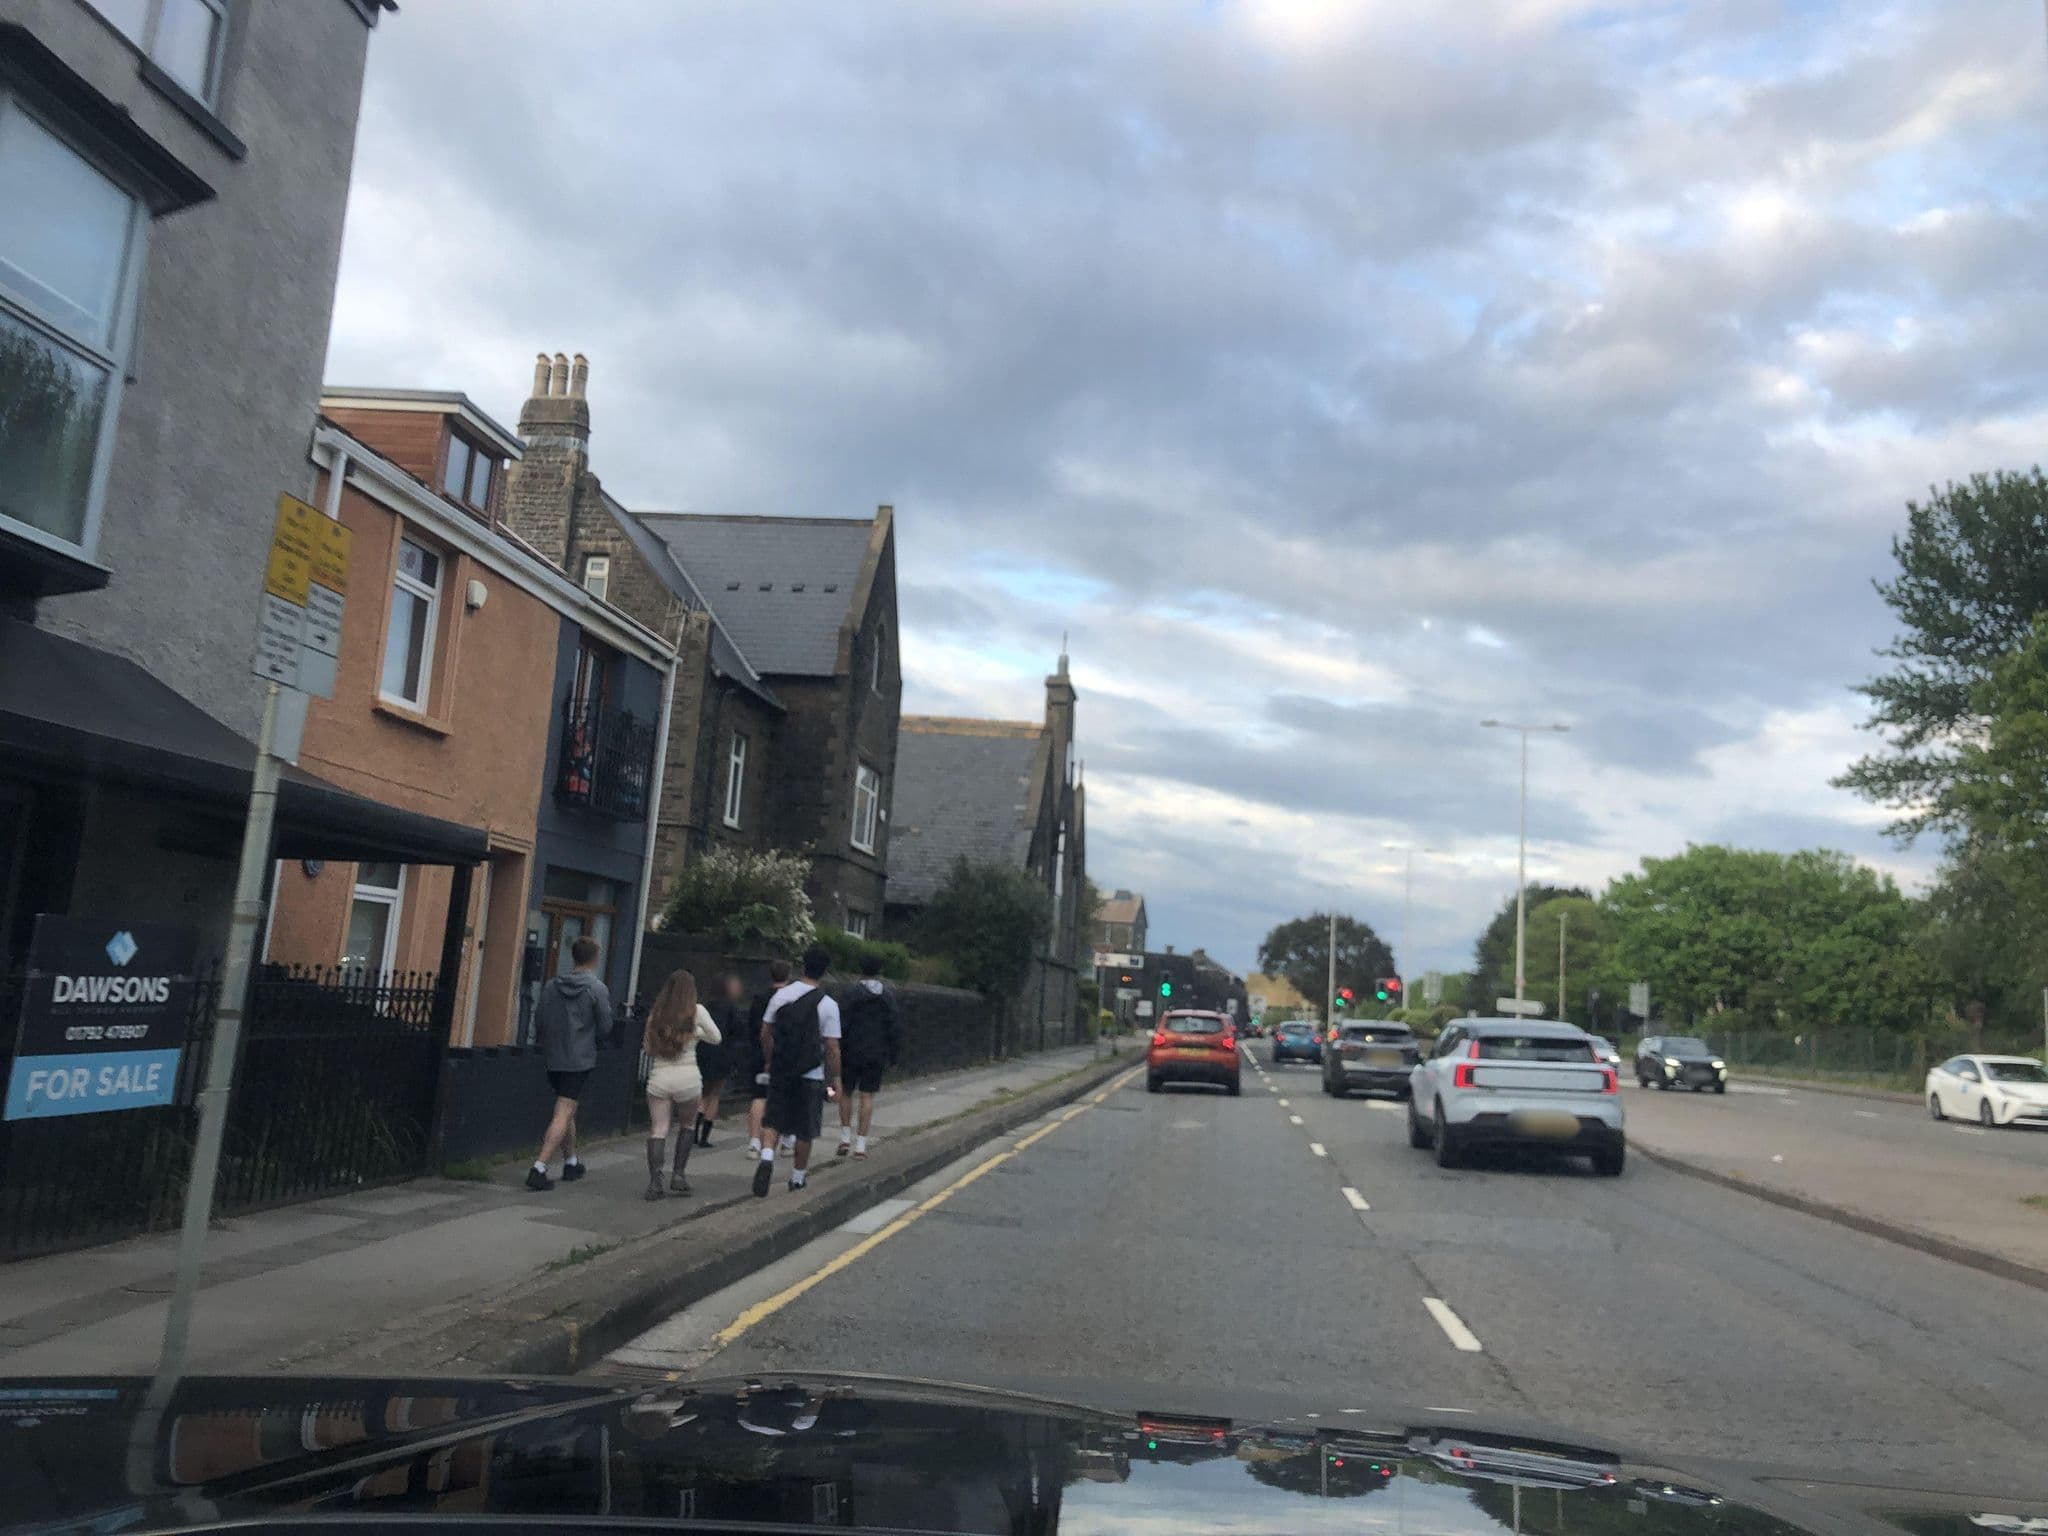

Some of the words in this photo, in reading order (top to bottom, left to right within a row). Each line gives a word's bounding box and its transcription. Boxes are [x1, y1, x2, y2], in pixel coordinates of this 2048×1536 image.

[53, 975, 170, 1002] DAWSONS
[25, 1067, 90, 1101] FOR
[96, 1063, 162, 1096] SALE
